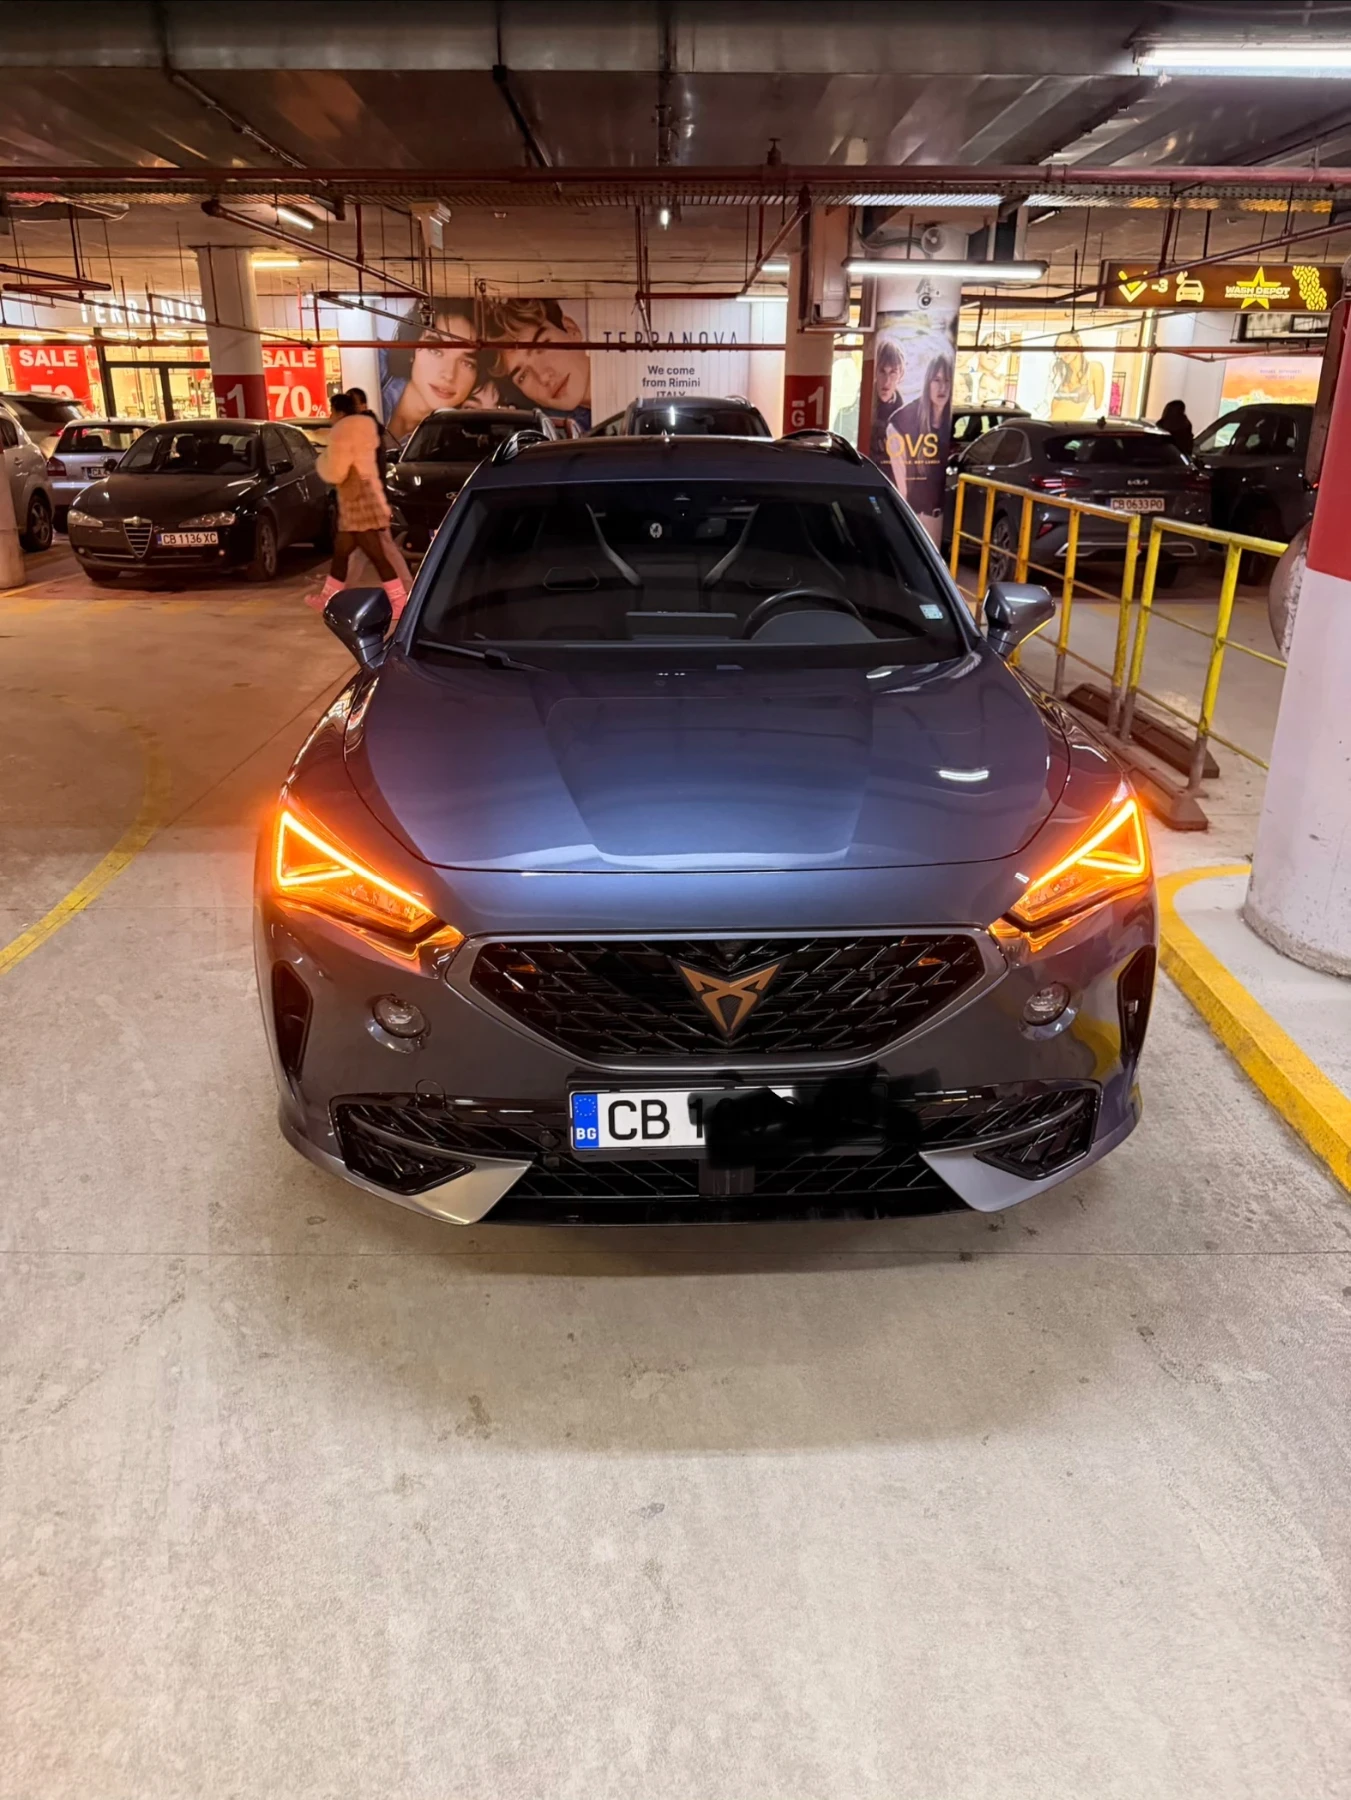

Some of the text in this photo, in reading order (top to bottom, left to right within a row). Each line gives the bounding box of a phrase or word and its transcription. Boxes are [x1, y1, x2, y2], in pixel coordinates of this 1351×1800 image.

[1151, 278, 1169, 293] -3
[1225, 286, 1291, 295] WASH DEPOT
[80, 298, 207, 324] TERRANOV
[603, 331, 739, 352] TERRANOVA
[18, 348, 79, 367] SALE
[262, 349, 317, 368] SALE
[647, 365, 695, 375] We come
[642, 377, 701, 387] from Rimini
[791, 409, 805, 427] G
[886, 433, 938, 458] OVS
[1126, 499, 1149, 510] 0633
[162, 534, 177, 545] CB
[178, 533, 202, 544] 1136
[203, 532, 217, 543] XC
[608, 1099, 670, 1140] CB
[576, 1127, 597, 1139] BG
